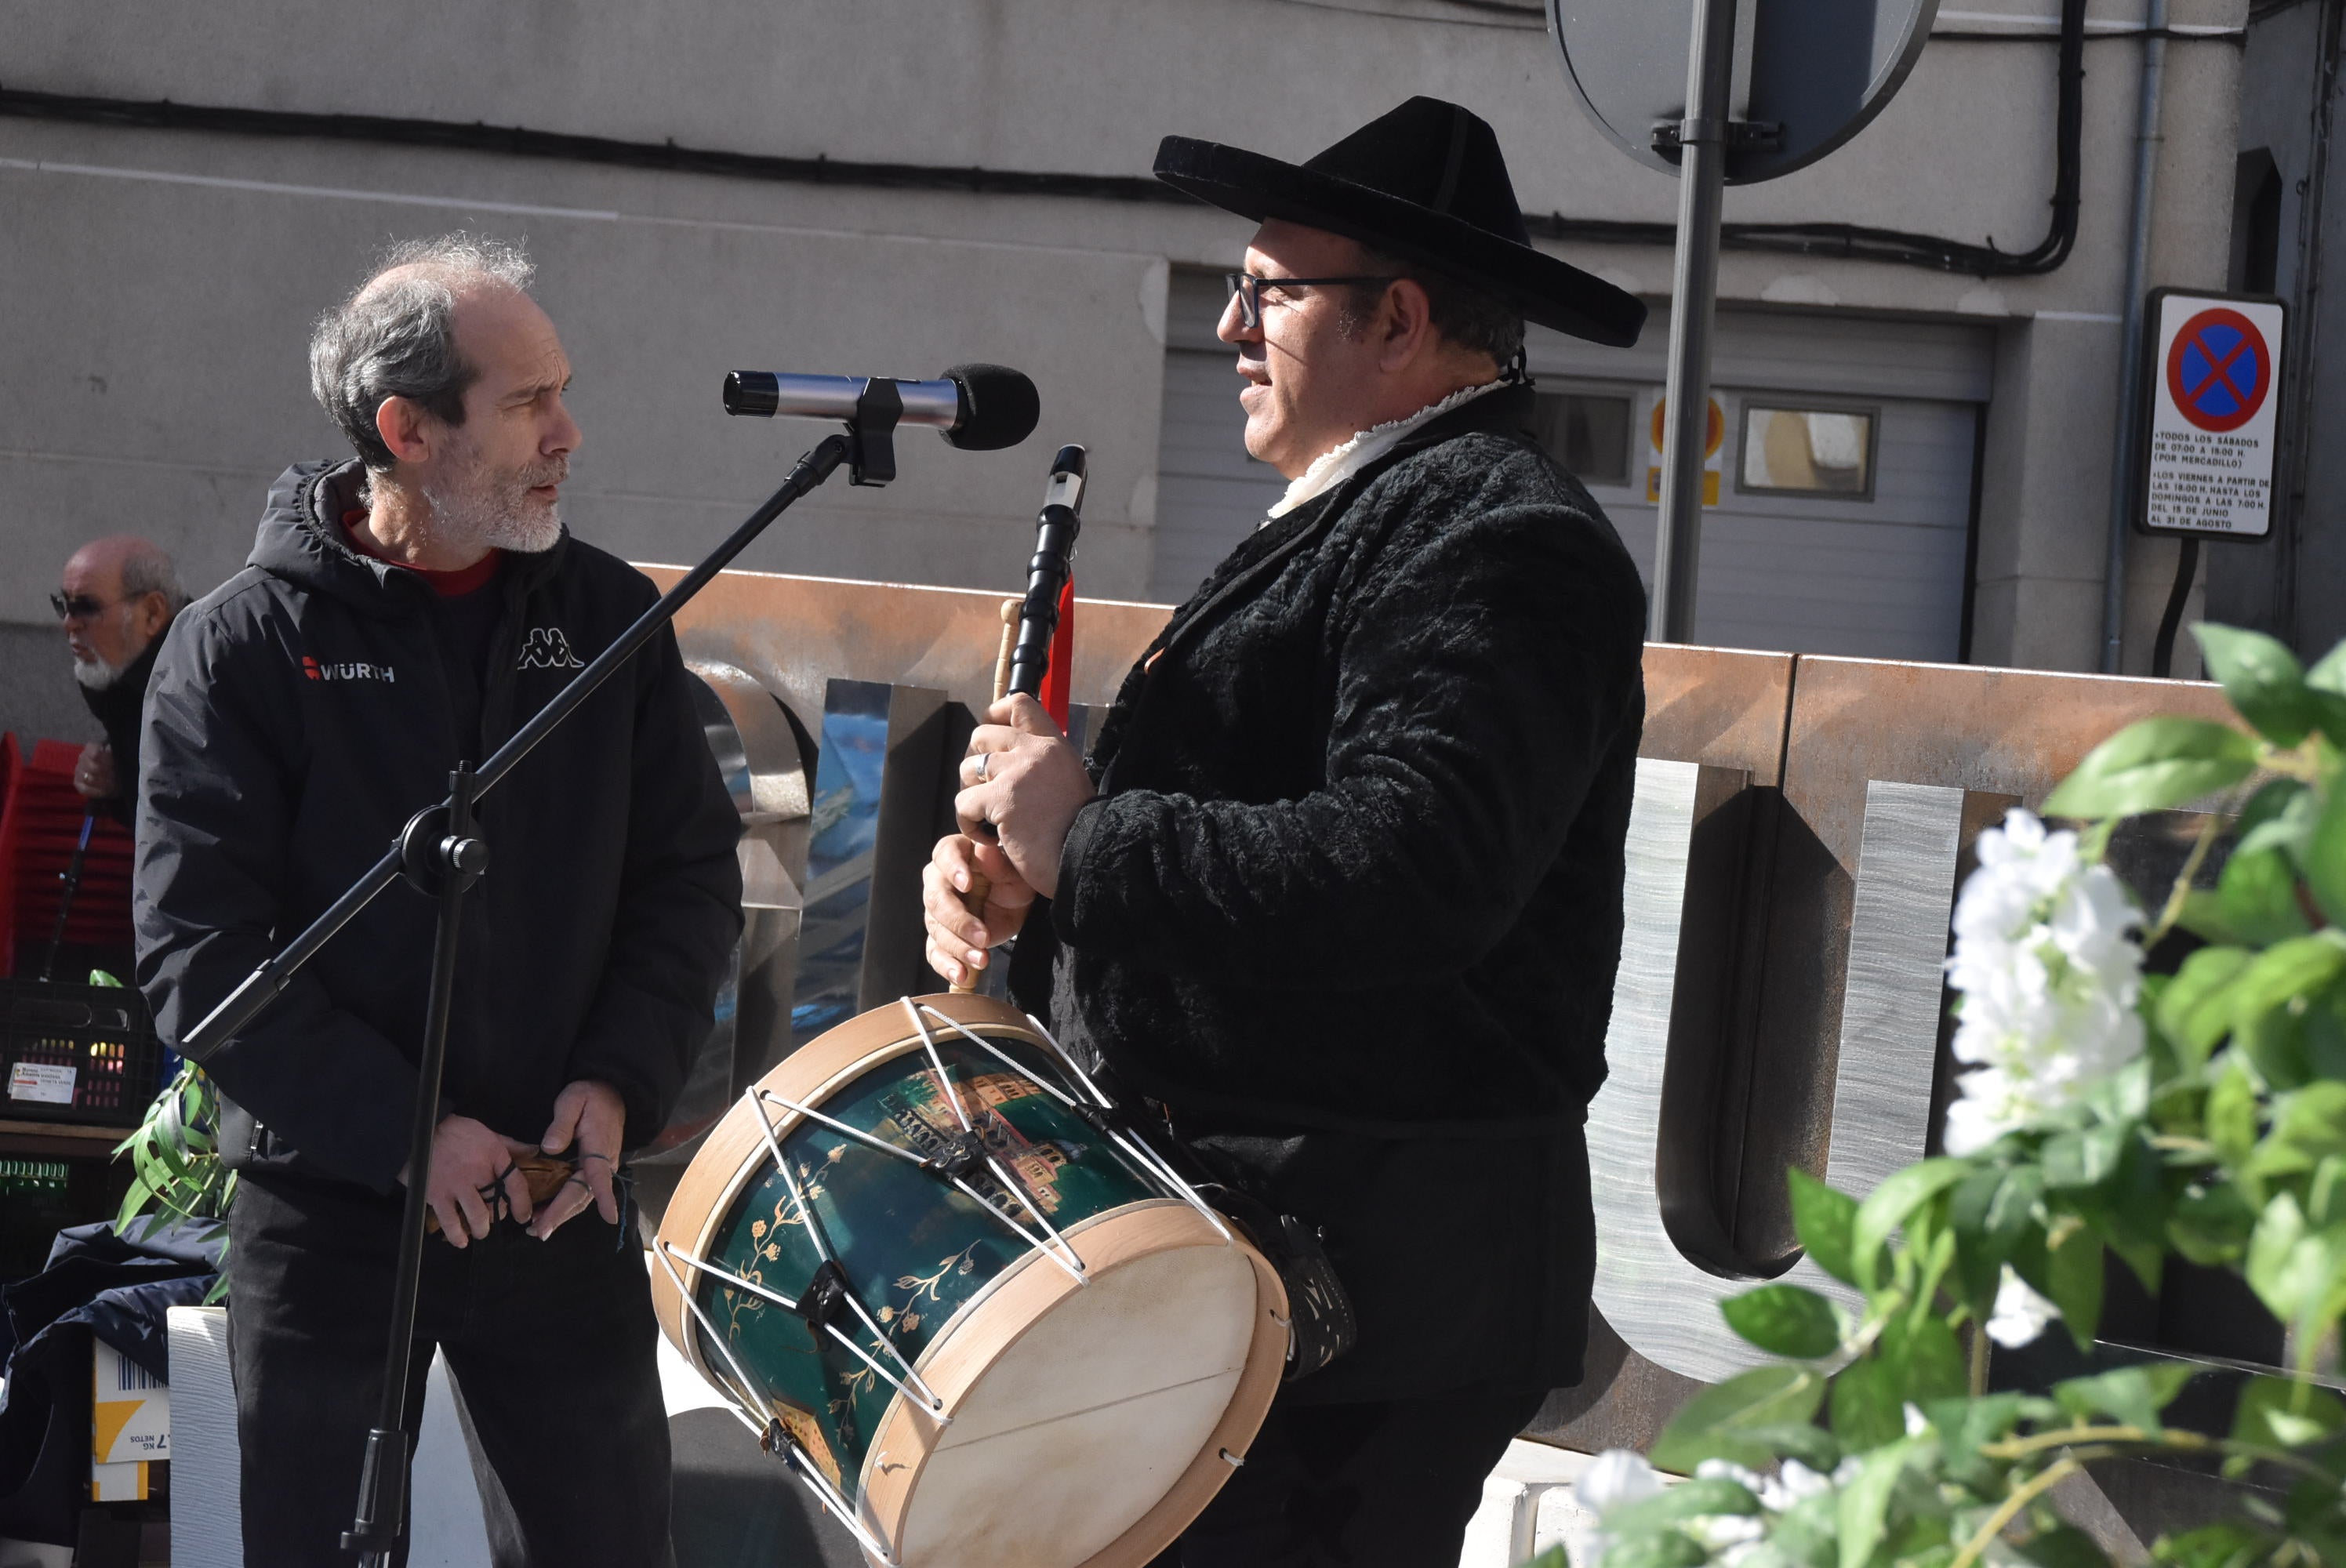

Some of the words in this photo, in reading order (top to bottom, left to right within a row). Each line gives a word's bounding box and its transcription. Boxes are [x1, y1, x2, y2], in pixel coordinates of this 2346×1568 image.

[2161, 432, 2190, 442] TODOS
[2195, 435, 2212, 444] LOS
[2217, 435, 2259, 448] SÁBADOS
[2154, 453, 2177, 463] (POR
[2181, 456, 2242, 468] MERCADILLO)
[2178, 473, 2213, 484] VIERNES
[2227, 476, 2255, 487] PARTIR
[2259, 479, 2269, 488] DE
[2210, 486, 2239, 495] HASTA
[2244, 489, 2261, 498] LOS
[2152, 493, 2200, 504] DOMINGOS
[2216, 498, 2232, 506] LAS
[2152, 503, 2167, 513] DEL
[2186, 506, 2196, 514] DE
[2202, 508, 2228, 517] JUNIO
[2151, 515, 2161, 524] AL
[2196, 518, 2232, 528] AGOSTO
[320, 662, 395, 683] WÜRTH
